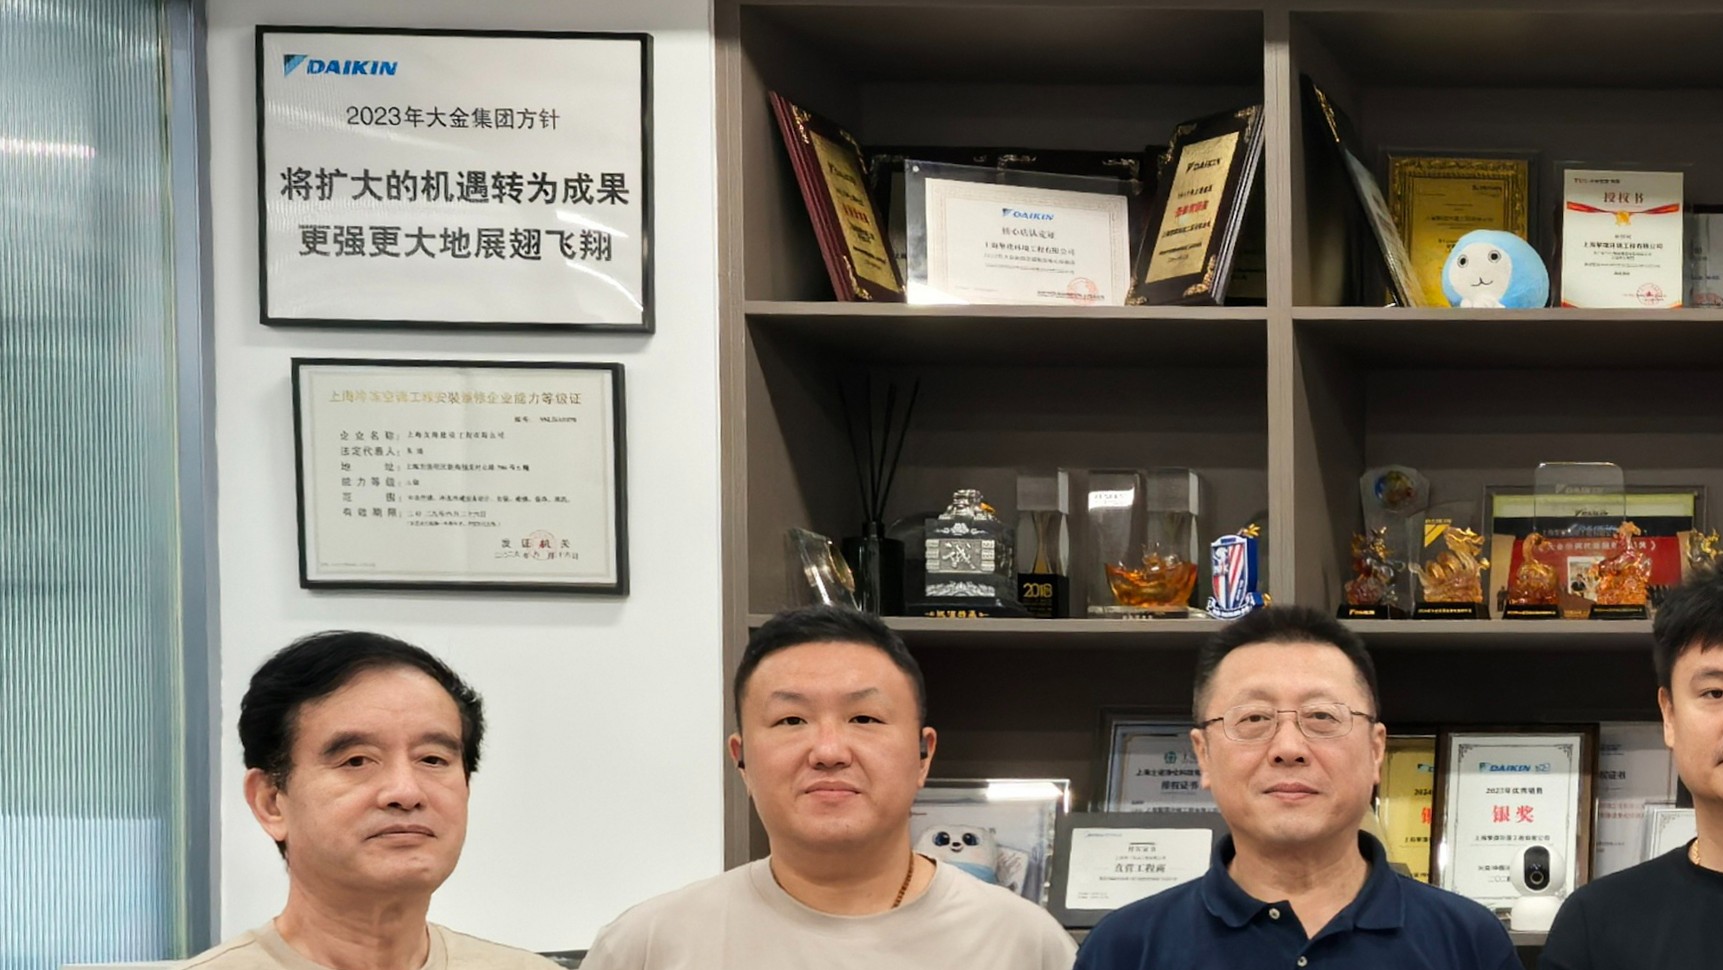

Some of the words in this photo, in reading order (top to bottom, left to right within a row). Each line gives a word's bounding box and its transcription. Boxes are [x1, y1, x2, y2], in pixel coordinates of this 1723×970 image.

[306, 58, 399, 77] DAIKIN
[345, 105, 561, 131] 2023年大金集团方针
[279, 166, 630, 206] 将扩大的机遇转为成果
[1013, 210, 1055, 221] DAIKIN
[299, 223, 613, 263] 更强更大地展翅飞翔
[1489, 764, 1532, 773] DAIKIN
[1492, 804, 1535, 824] 银奖
